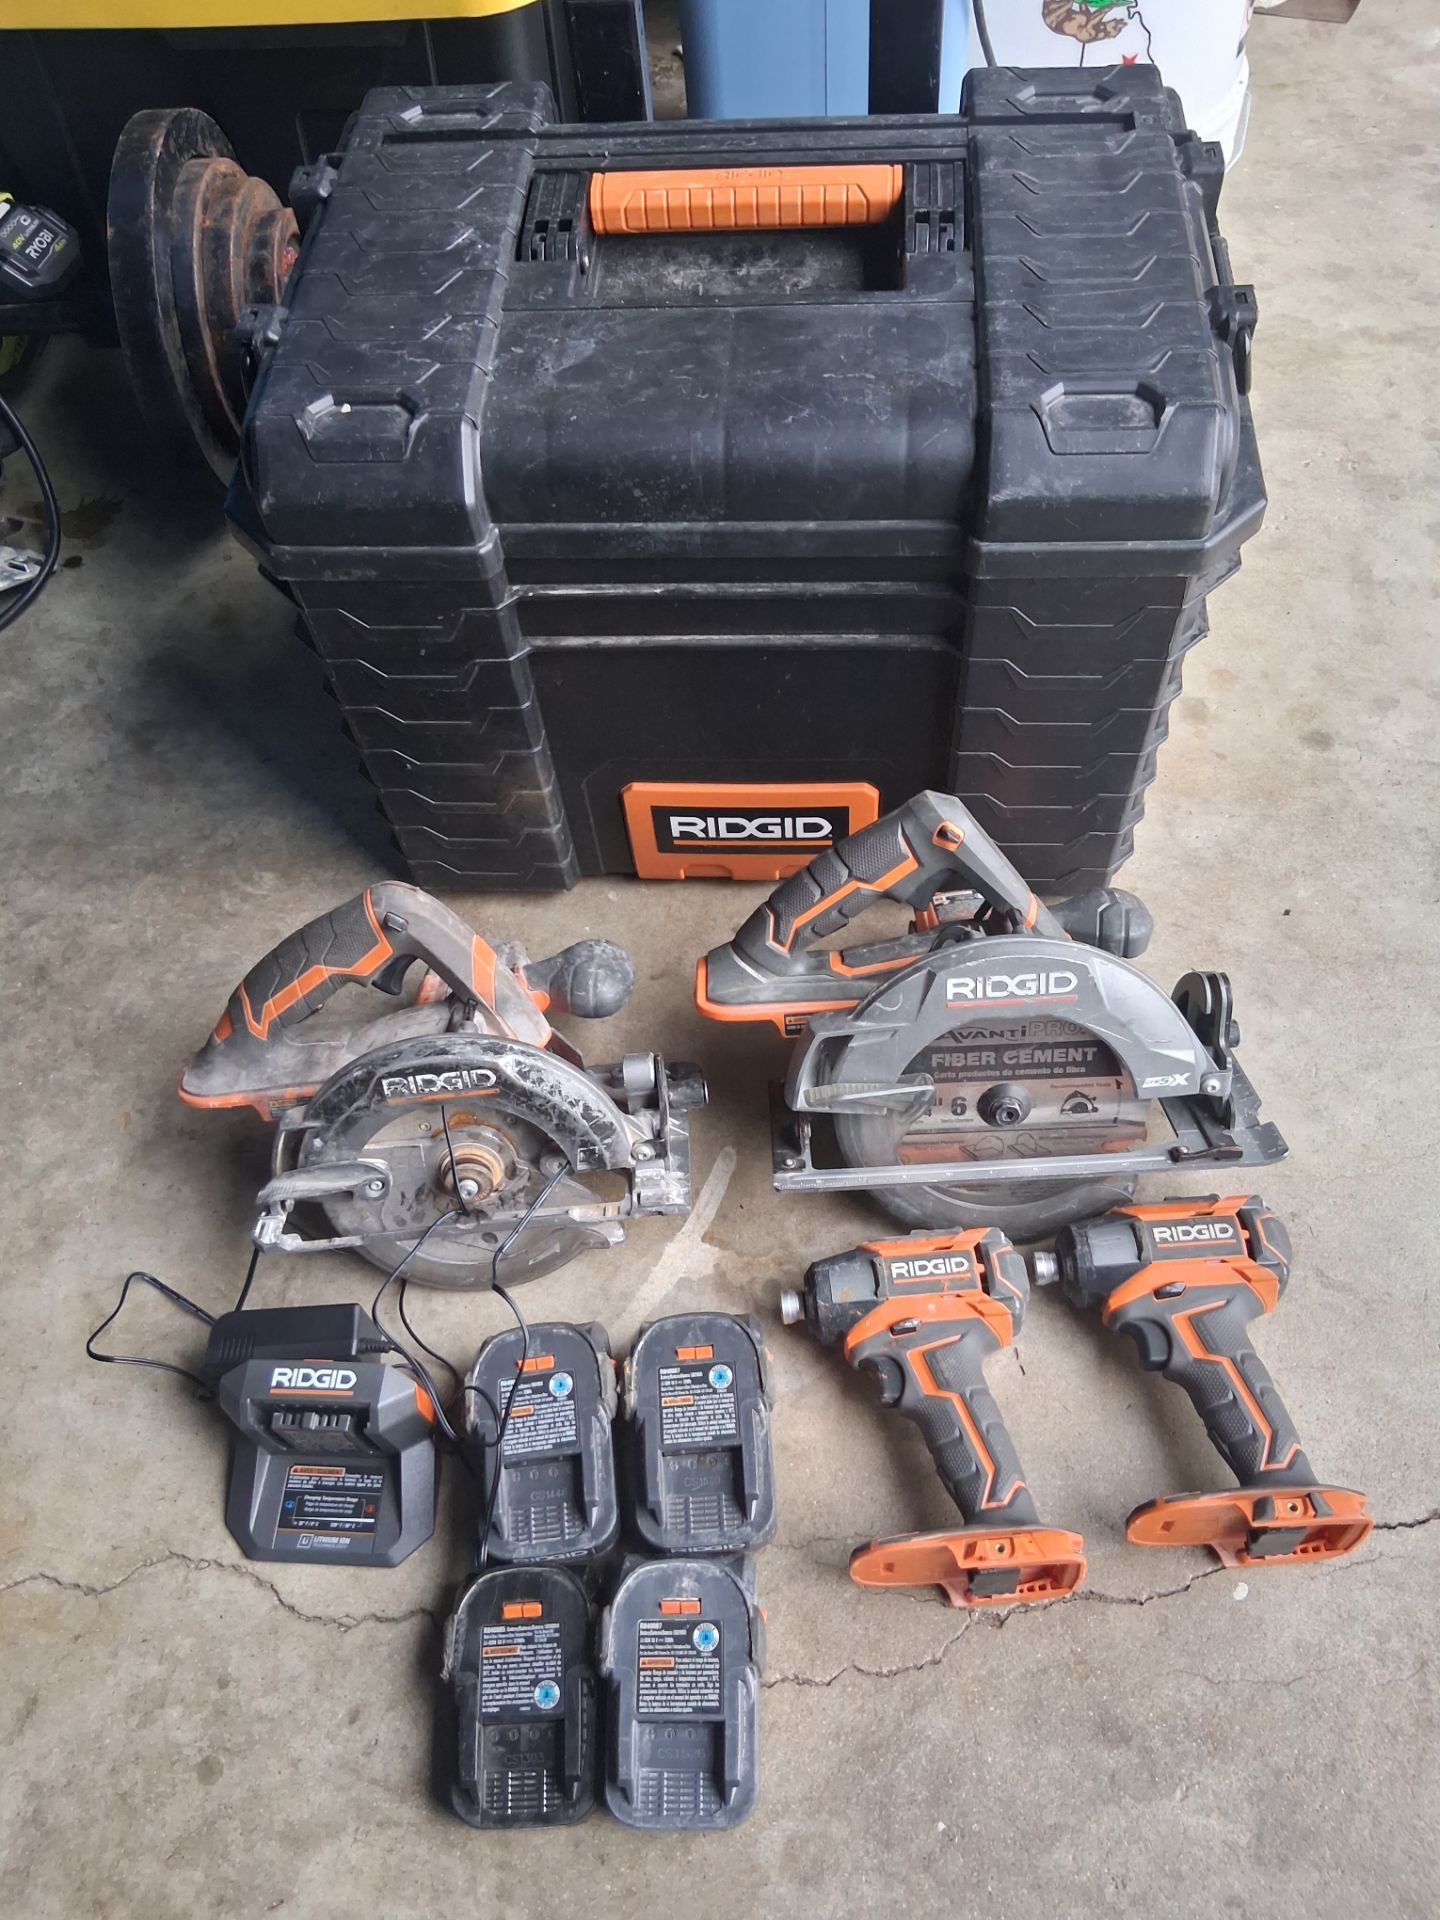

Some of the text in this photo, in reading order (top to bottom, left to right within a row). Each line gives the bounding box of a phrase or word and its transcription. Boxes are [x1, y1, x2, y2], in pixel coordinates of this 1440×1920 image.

[25, 229, 54, 259] RYOBI
[669, 816, 833, 838] RIDGID
[946, 970, 1079, 1001] RIDGID
[931, 1046, 1098, 1068] FIBER CEMENT
[1002, 1068, 1014, 1077] de
[1015, 1066, 1052, 1077] cemento
[1053, 1065, 1065, 1075] de
[382, 1068, 498, 1097] RIDGID
[951, 1096, 968, 1117] 6
[1152, 1222, 1234, 1243] RIDGID
[890, 1256, 970, 1279] RIDGID
[270, 1367, 358, 1390] RIDGID
[670, 1542, 747, 1554] RIDGID
